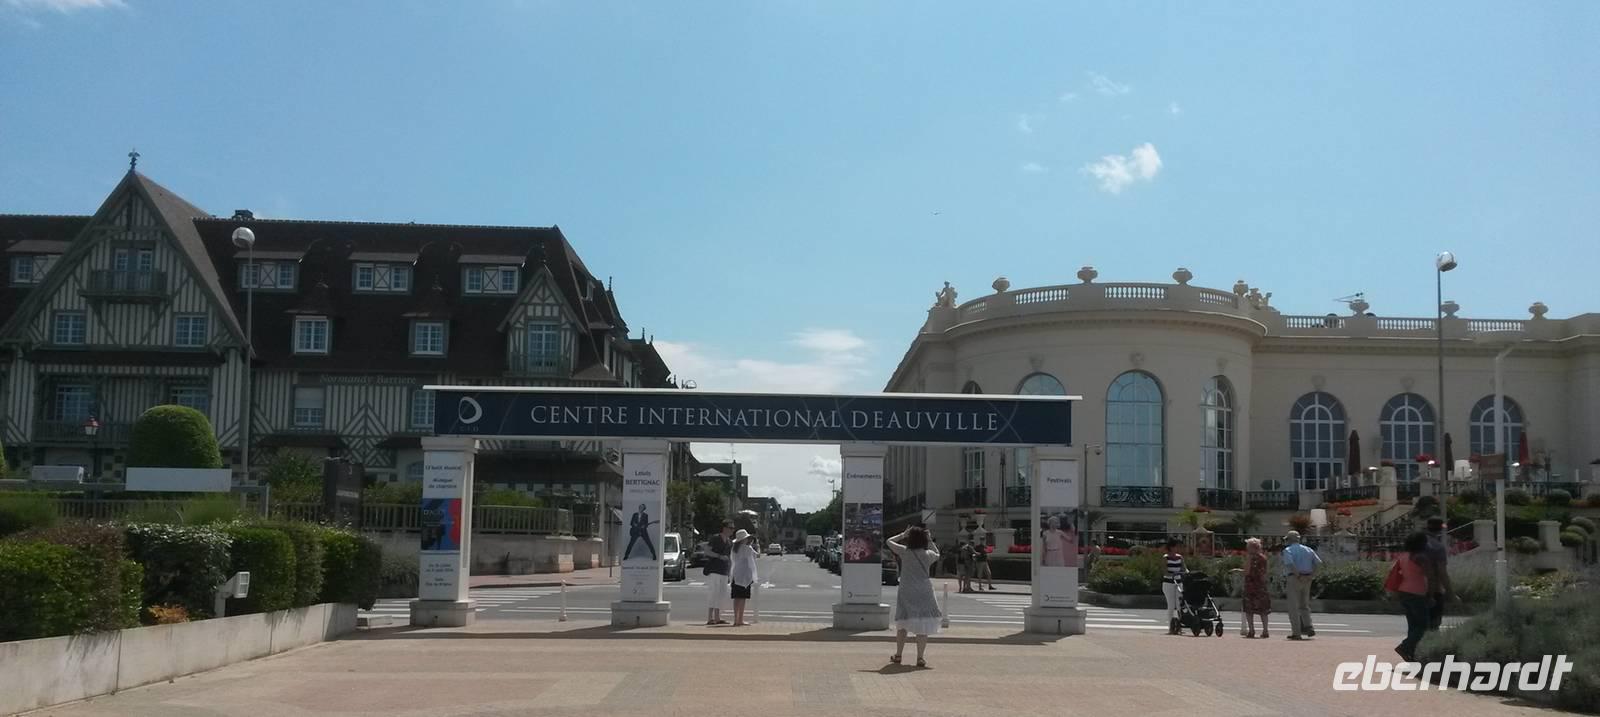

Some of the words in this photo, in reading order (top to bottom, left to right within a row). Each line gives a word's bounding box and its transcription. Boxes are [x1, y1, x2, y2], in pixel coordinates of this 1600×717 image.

[320, 374, 374, 385] Normandy
[530, 405, 628, 425] CENTRE
[637, 406, 842, 428] INTERNATIONAL
[852, 411, 998, 431] DEAUVILLE
